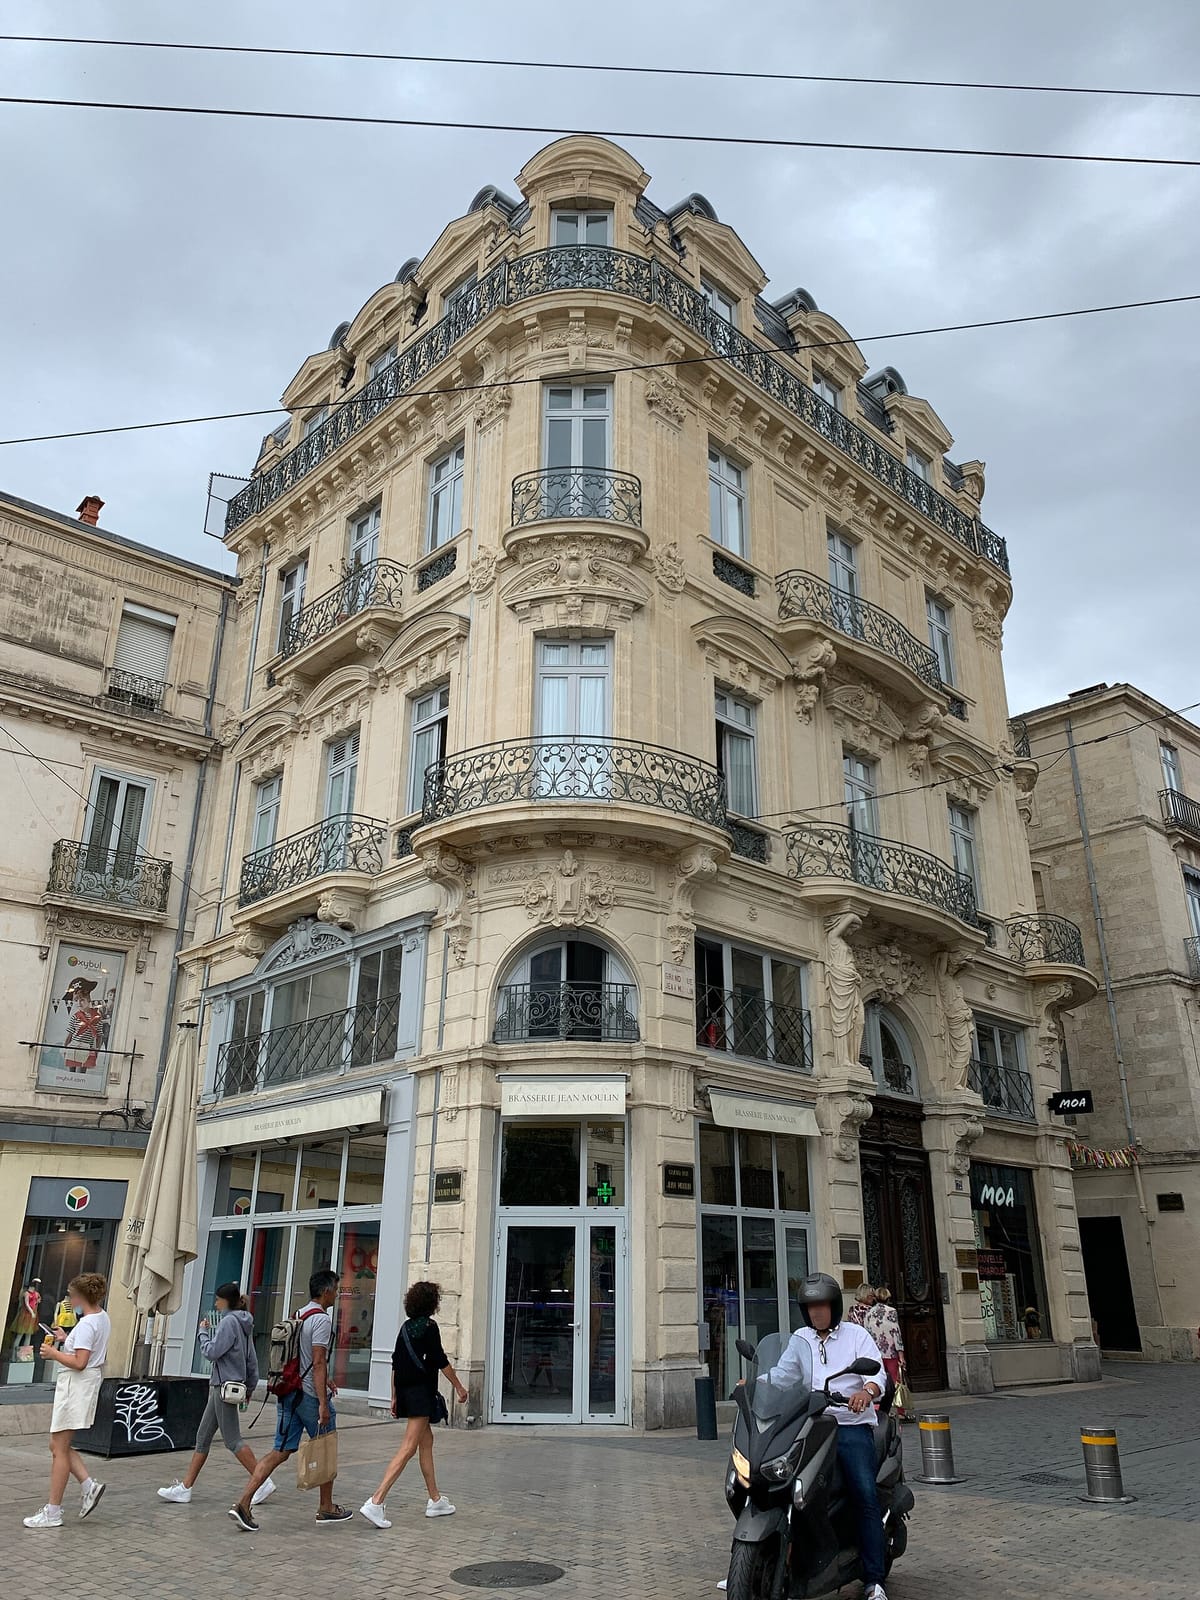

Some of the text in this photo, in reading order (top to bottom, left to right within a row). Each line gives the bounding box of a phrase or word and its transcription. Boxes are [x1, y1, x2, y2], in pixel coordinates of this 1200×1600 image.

[508, 1093, 619, 1103] BRASSERIE JEAN MOULIN
[1059, 1097, 1086, 1109] MOA
[980, 1183, 1015, 1208] MOA
